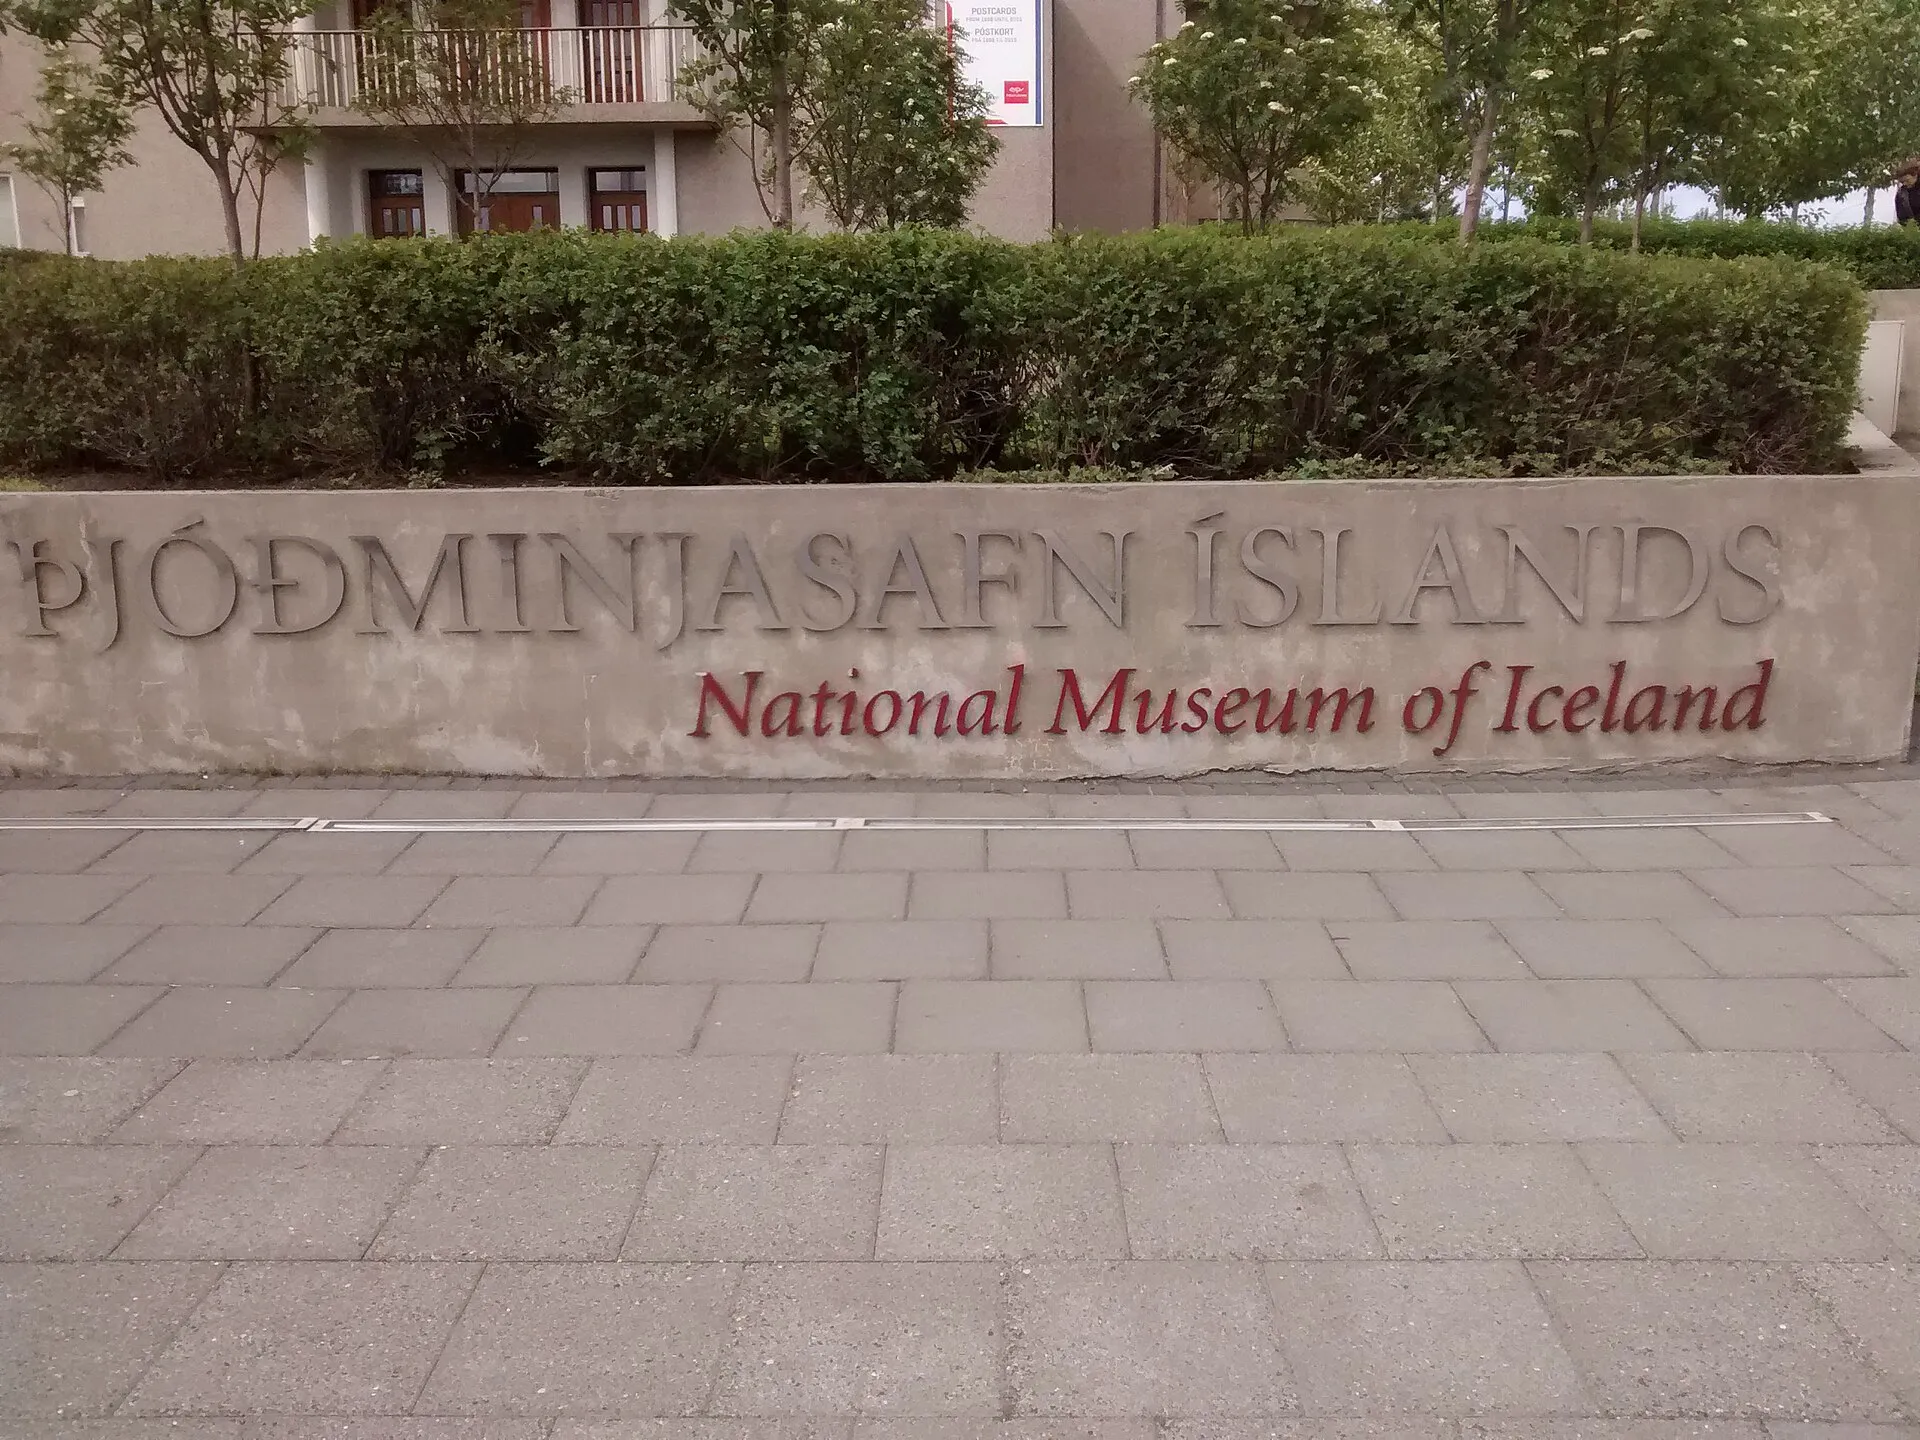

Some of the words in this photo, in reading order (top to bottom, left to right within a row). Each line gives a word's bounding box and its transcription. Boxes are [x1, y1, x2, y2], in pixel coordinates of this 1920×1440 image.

[971, 7, 1017, 15] POSTCARDS
[974, 27, 1014, 36] PÓSTKORT
[1184, 510, 1785, 628] ÍSLANDS
[687, 663, 1025, 739] National
[1043, 667, 1376, 736] Museum
[1402, 659, 1492, 758] of
[1492, 657, 1776, 734] Iceland
